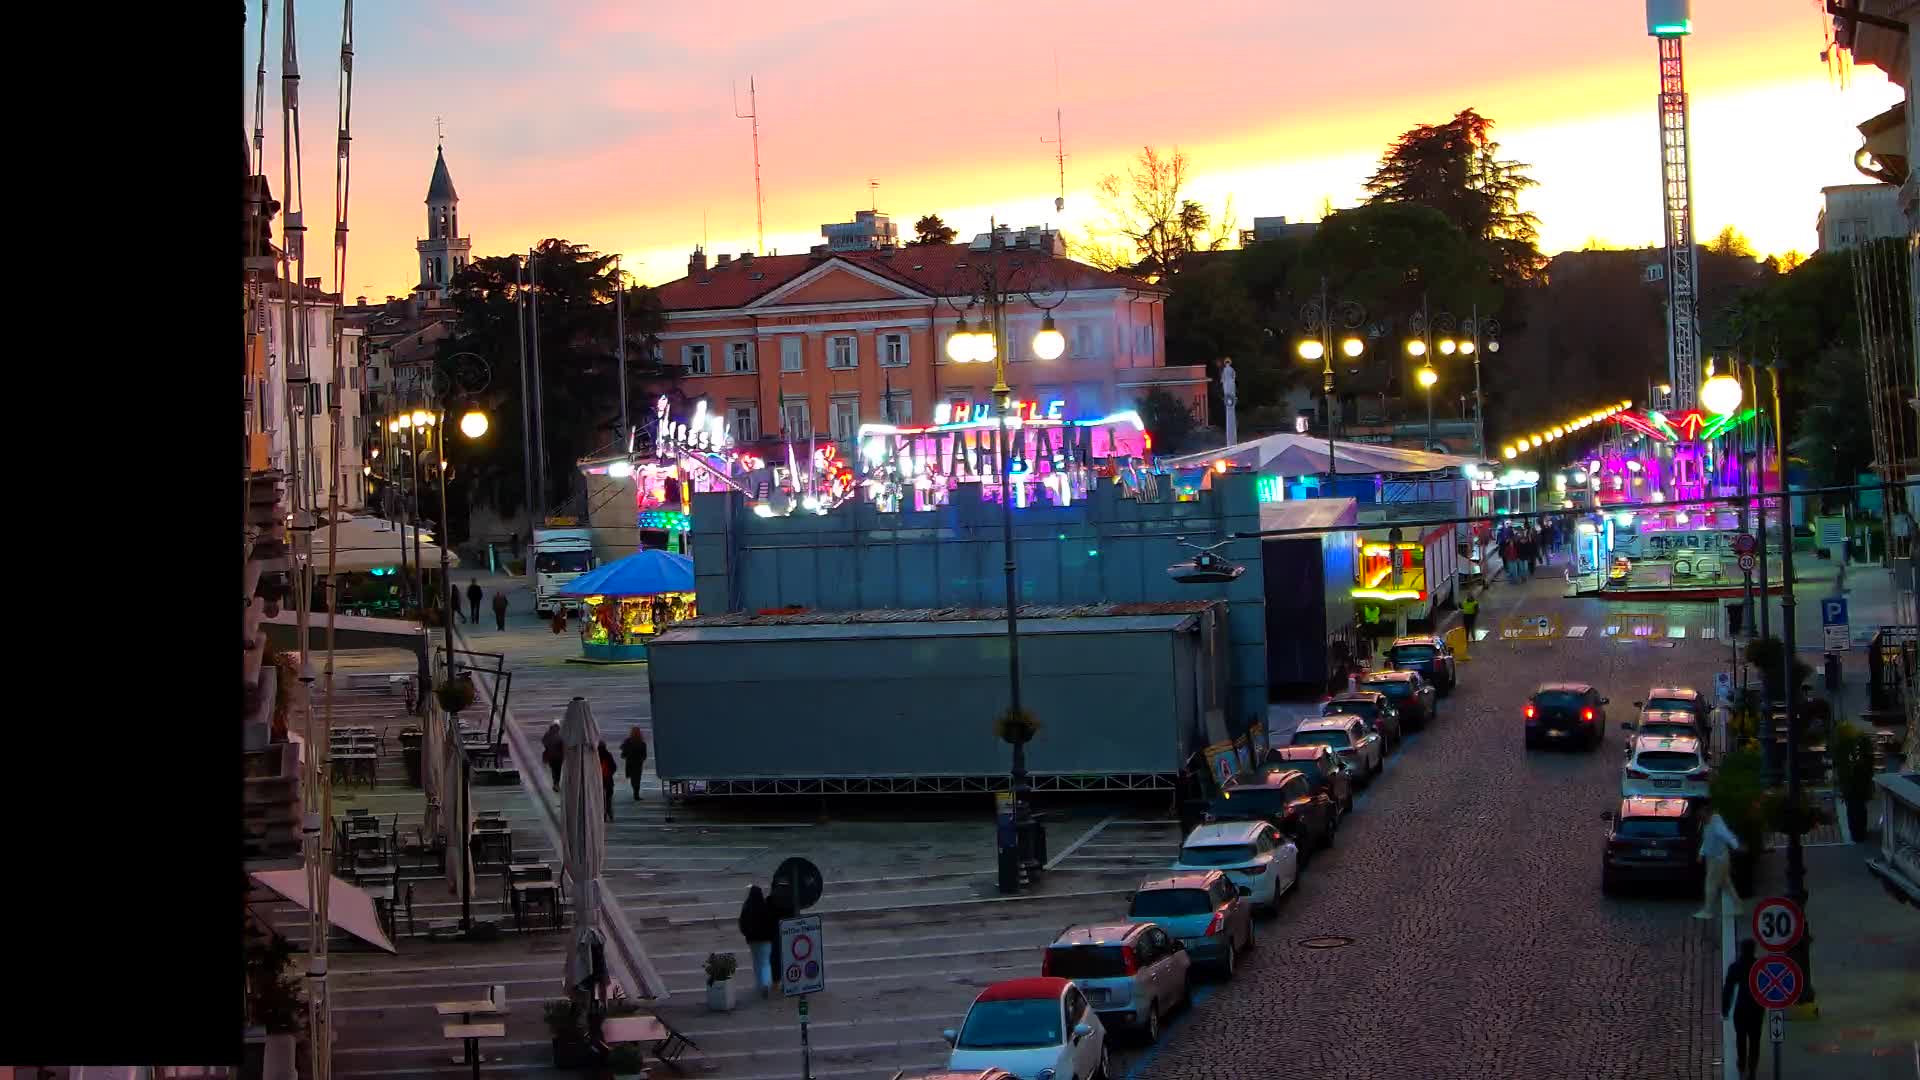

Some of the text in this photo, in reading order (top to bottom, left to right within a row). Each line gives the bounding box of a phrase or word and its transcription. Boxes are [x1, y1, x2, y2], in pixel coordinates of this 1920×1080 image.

[935, 400, 1065, 424] SHUTLE
[1825, 602, 1842, 621] P
[1762, 912, 1791, 938] 30
